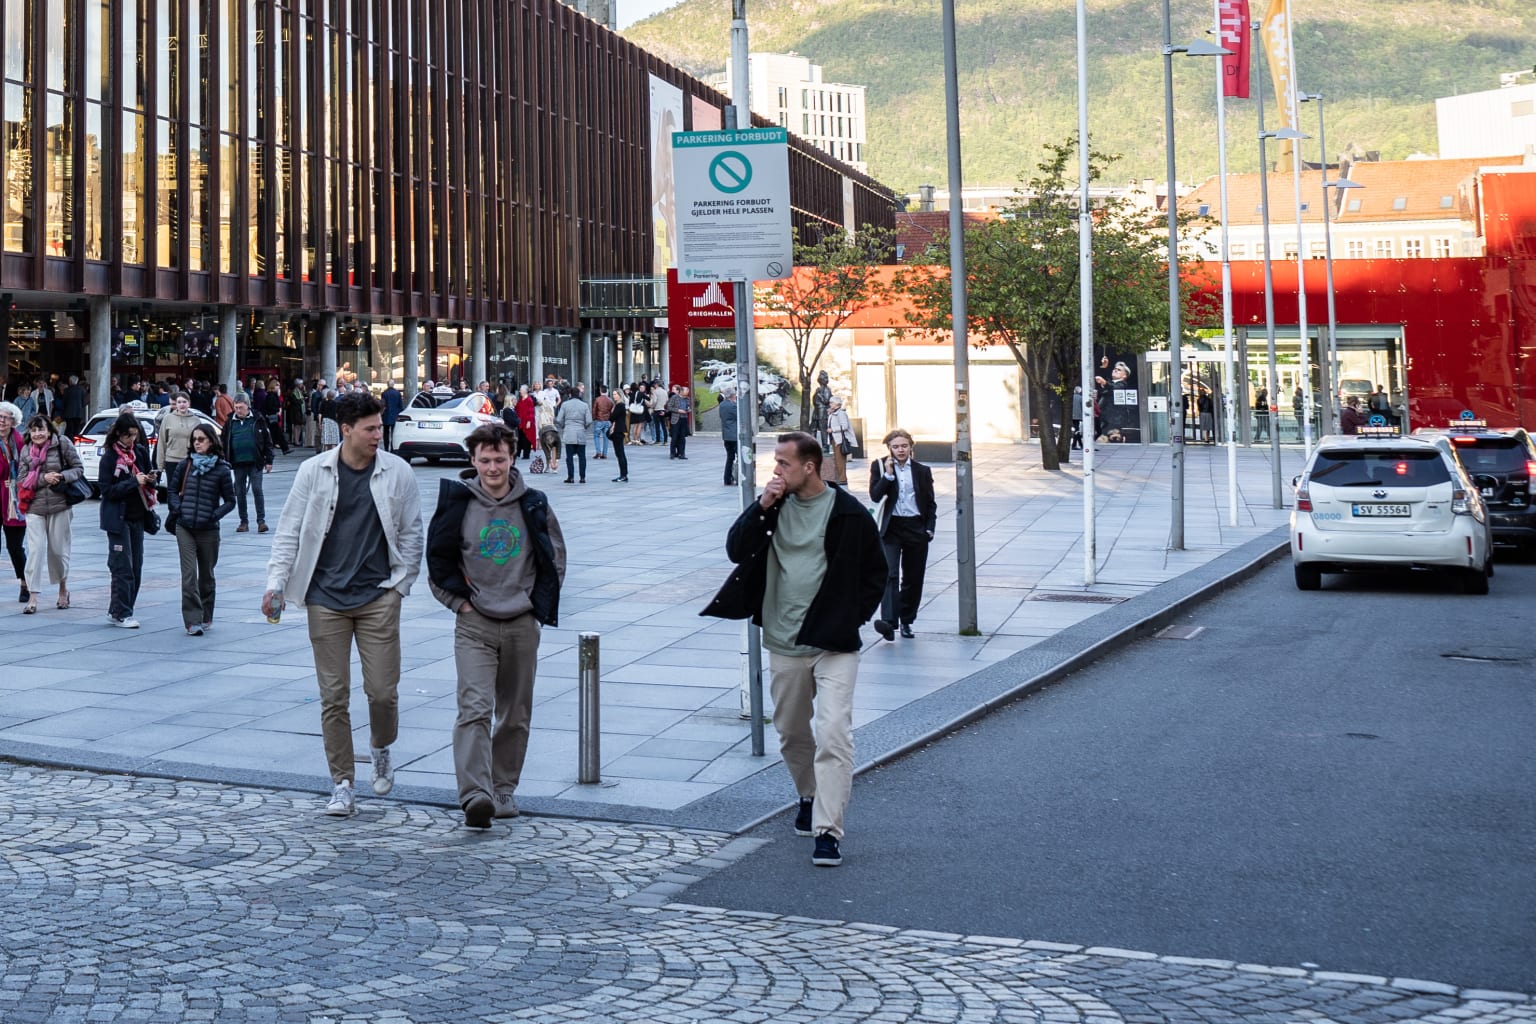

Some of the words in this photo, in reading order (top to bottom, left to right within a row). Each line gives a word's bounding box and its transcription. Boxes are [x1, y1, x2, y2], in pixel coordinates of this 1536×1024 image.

[676, 134, 733, 145] PARKERING
[735, 131, 783, 142] FORBUDT
[693, 199, 735, 207] PARKERING
[736, 198, 771, 206] FORBUDT
[691, 207, 721, 217] GJELDER
[722, 207, 740, 215] HELE
[742, 207, 774, 215] PLASSEN
[1361, 504, 1372, 514] SV
[1378, 504, 1408, 514] 55564
[1313, 512, 1342, 520] 08000
